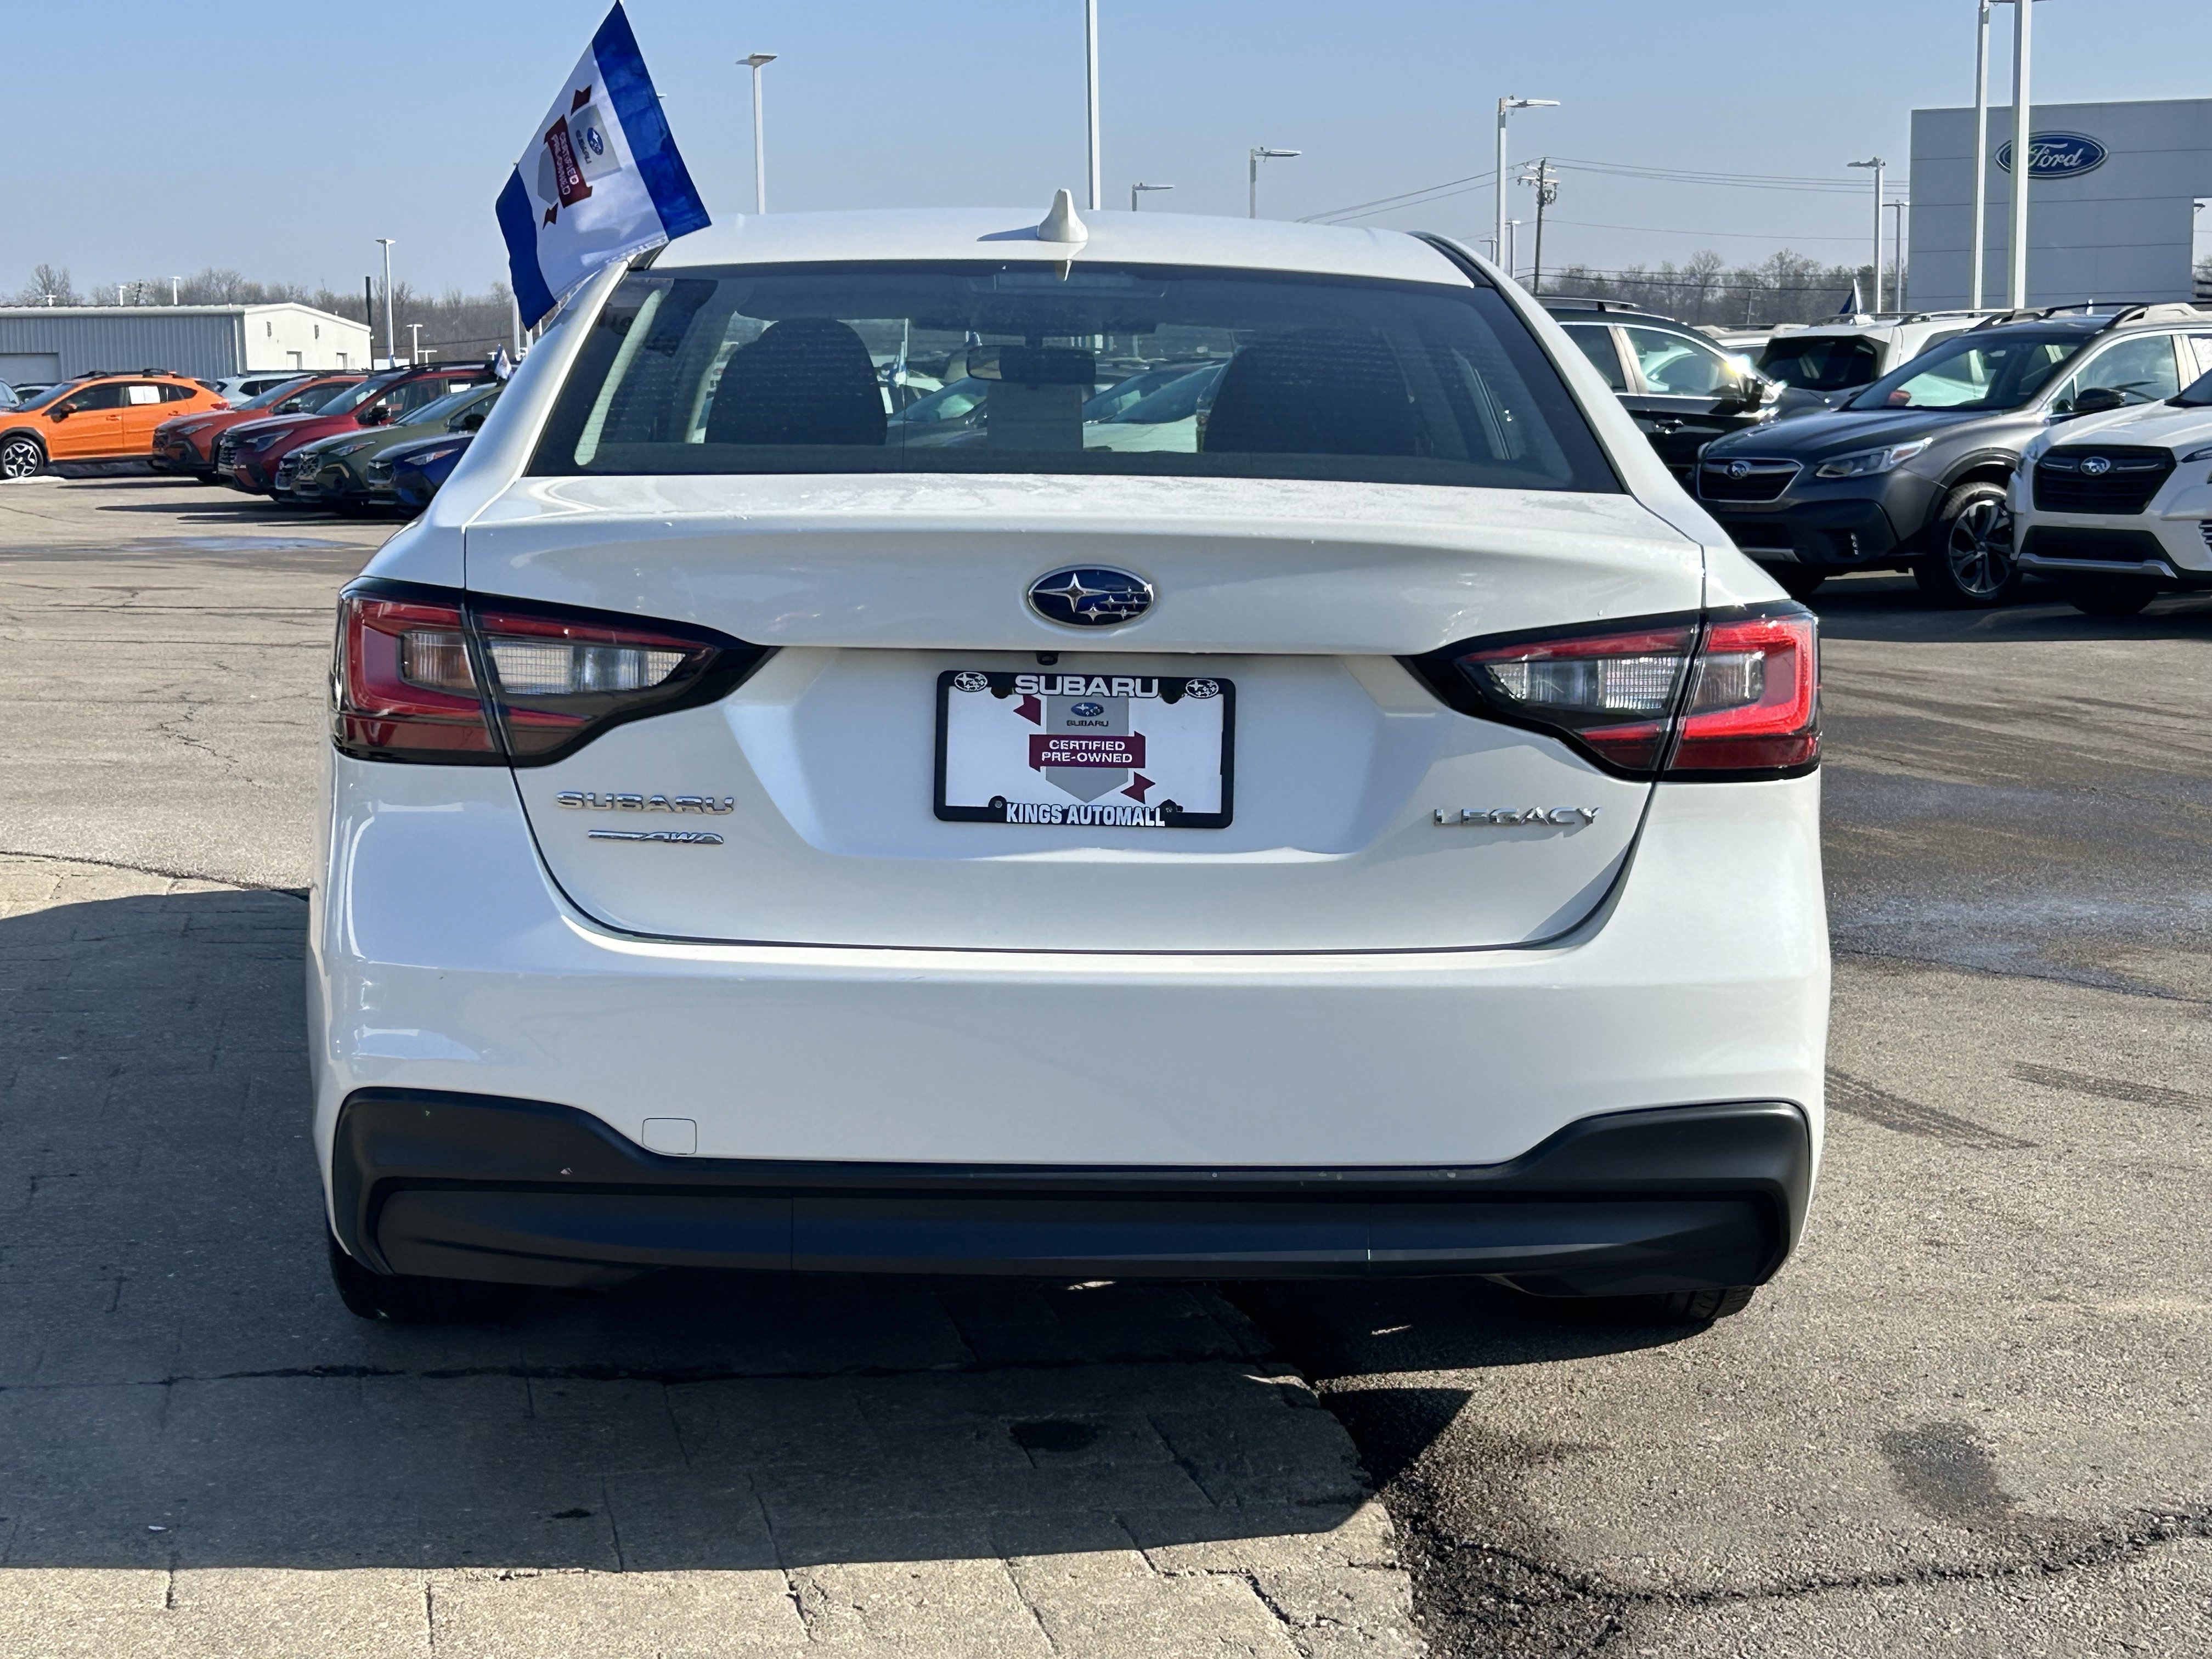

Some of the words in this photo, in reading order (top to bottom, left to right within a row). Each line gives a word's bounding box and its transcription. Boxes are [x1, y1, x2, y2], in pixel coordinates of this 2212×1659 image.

[2029, 142, 2085, 167] Ford
[1014, 674, 1159, 698] SUBARU
[1041, 752, 1133, 763] PRE-OWNED
[1048, 739, 1126, 752] CERTIFIED
[556, 791, 735, 815] SUBARU
[1006, 803, 1063, 825] KINGS
[1066, 804, 1166, 827] AUTOMALL
[1433, 806, 1603, 826] LEGACY
